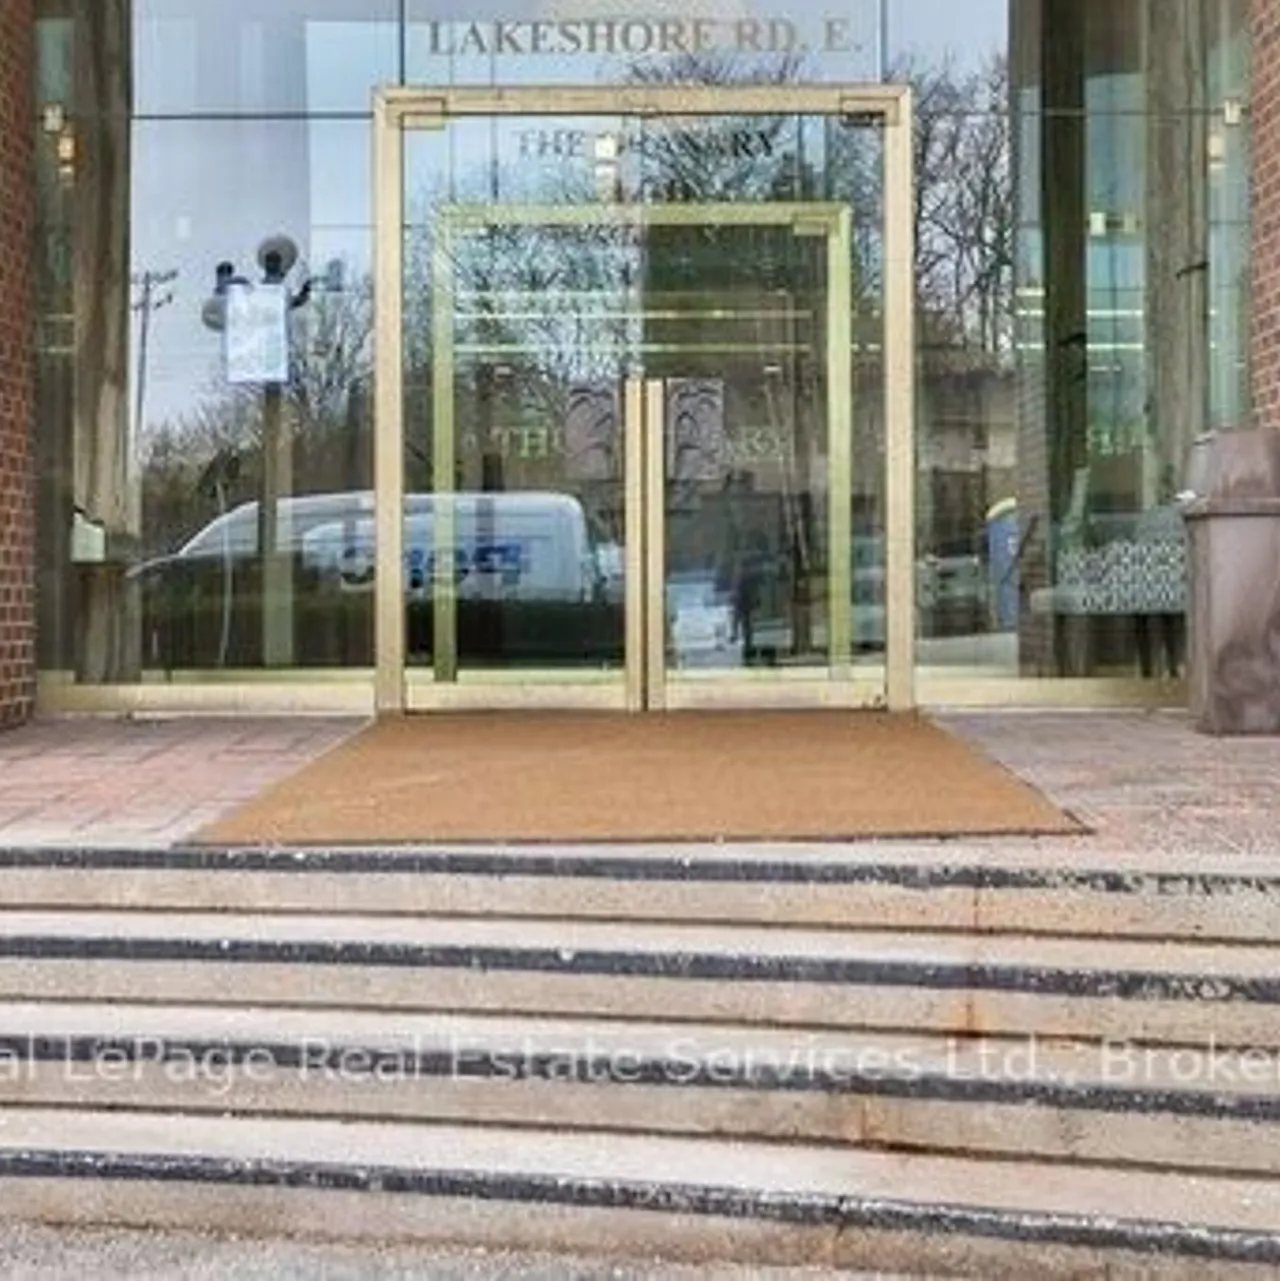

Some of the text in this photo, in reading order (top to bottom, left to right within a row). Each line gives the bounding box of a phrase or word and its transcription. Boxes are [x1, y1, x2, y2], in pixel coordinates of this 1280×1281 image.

[428, 19, 863, 55] LAKESHORE RD. E.
[512, 129, 586, 158] THE
